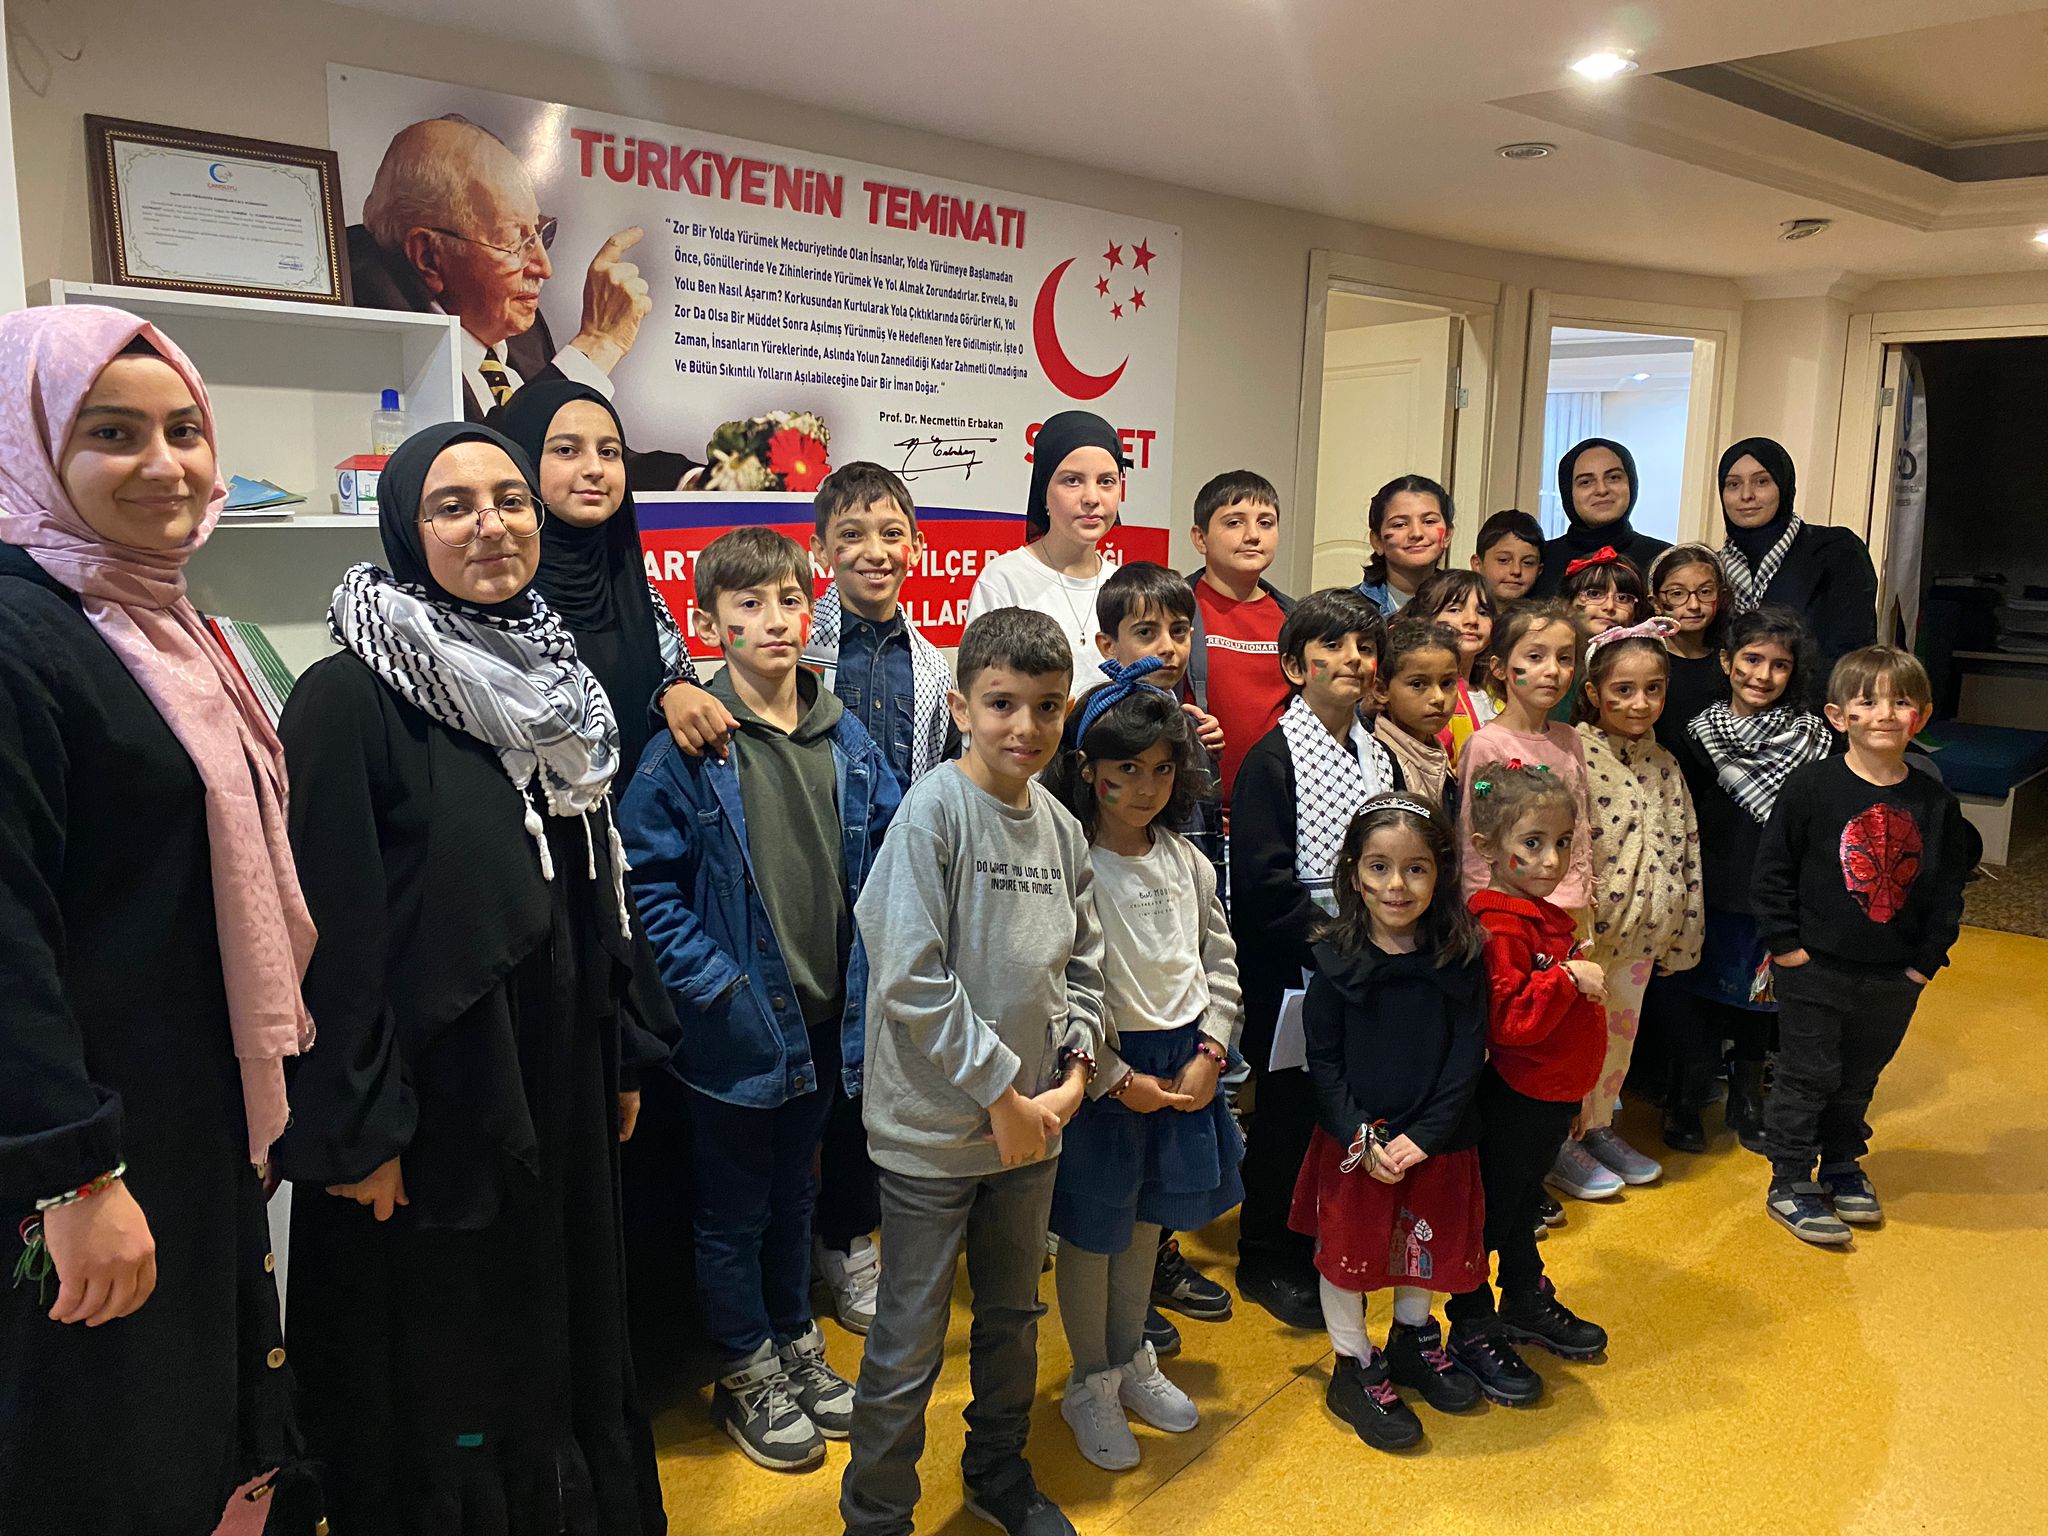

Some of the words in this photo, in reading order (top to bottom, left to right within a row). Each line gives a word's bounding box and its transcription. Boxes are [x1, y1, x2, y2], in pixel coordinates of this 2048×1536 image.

[863, 181, 1026, 249] TEMİNATI
[673, 221, 690, 235] Zor
[692, 224, 707, 237] Bir
[709, 226, 735, 242] Yolda
[737, 230, 778, 248] Yürümek
[781, 237, 848, 258] Mecburiyetinde
[849, 248, 868, 262] Olan
[870, 247, 905, 269] İnsanlar,
[907, 256, 928, 270] Yolda
[930, 260, 968, 278] Yürümeye
[969, 266, 1013, 283] Başlamadan
[675, 245, 701, 267] Önce,
[703, 253, 764, 272] Gönüllerinde
[766, 262, 777, 274] Ve
[779, 264, 832, 282] Zihinlerinde
[834, 271, 872, 287] Yürümek
[873, 277, 883, 289] Ve
[885, 278, 897, 291] Yol
[899, 281, 924, 295] Almak
[926, 284, 980, 303] Zorundadırlar.
[981, 294, 1007, 308] Evvela,
[1009, 296, 1018, 308] Bu
[675, 277, 695, 291] Yolu
[698, 280, 716, 294] Ben
[719, 282, 742, 297] Nasıl
[745, 286, 782, 302] Aşarım?
[785, 291, 842, 309] Korkusundan
[844, 298, 889, 315] Kurtularak
[891, 304, 907, 318] Yola
[909, 307, 958, 324] Çıktıklarında
[960, 313, 991, 327] Görürler
[1005, 319, 1015, 331] Yol
[675, 304, 691, 317] Zor
[693, 306, 705, 319] Da
[708, 308, 728, 322] Olsa
[731, 311, 745, 324] Bir
[747, 313, 781, 328] Müddet
[783, 317, 808, 331] Sonra
[810, 320, 842, 337] Aşılmış
[844, 324, 886, 342] Yürünmüş
[887, 329, 897, 341] Ve
[899, 330, 943, 346] Hedeflenen
[944, 336, 961, 348] Yere
[1018, 344, 1024, 355] O
[675, 332, 709, 349] Zaman,
[712, 332, 759, 352] İnsanların
[761, 341, 821, 360] Yüreklerinde,
[823, 348, 855, 362] Aslında
[856, 351, 879, 364] Yolun
[881, 353, 929, 370] Zannedildiği
[931, 358, 953, 371] Kadar
[955, 361, 987, 374] Zahmetli
[988, 364, 1027, 379] Olmadığına
[675, 359, 687, 372] Ve
[689, 360, 717, 375] Bütün
[719, 364, 755, 378] Sıkıntılı
[757, 366, 792, 381] Yolların
[794, 370, 859, 389] Aşılabileceğine
[861, 376, 877, 389] Dair
[880, 377, 892, 390] Bir
[894, 376, 913, 391] İman
[879, 412, 902, 424] Prof.
[904, 414, 917, 425] Dr.
[919, 414, 966, 427] Necmettin
[968, 417, 1004, 430] Erbakan
[921, 543, 977, 583] İLÇE
[1208, 638, 1279, 651] REVOLUTIONARY
[977, 861, 987, 872] DO
[990, 862, 1008, 875] WHAT
[1012, 864, 1022, 877] YOU
[1025, 866, 1039, 879] LOVE
[1041, 868, 1049, 880] TO
[1051, 868, 1061, 880] DO
[991, 878, 1017, 891] INSPIRE
[1018, 881, 1030, 893] THE
[1032, 882, 1053, 895] FUTURE
